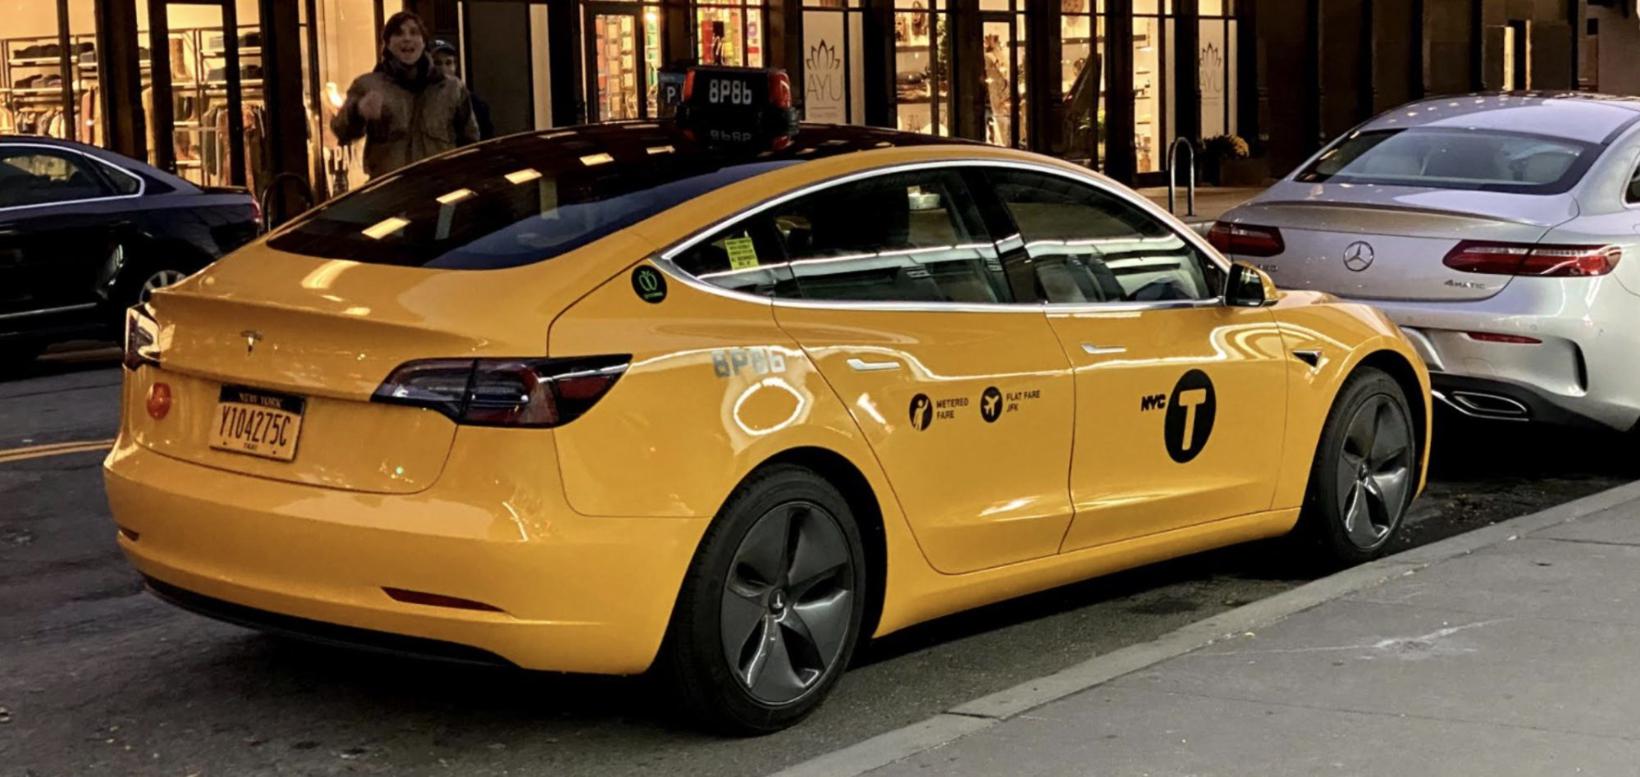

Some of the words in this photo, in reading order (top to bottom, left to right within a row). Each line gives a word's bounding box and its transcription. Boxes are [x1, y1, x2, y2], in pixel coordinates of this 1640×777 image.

[667, 86, 676, 104] P
[807, 74, 844, 101] AYU
[240, 393, 258, 403] NEW
[260, 396, 281, 408] YORK
[1006, 392, 1022, 401] FLAT
[1024, 390, 1041, 399] FARE
[936, 398, 969, 409] METERED
[1006, 403, 1019, 413] JFK
[937, 410, 955, 420] FARE
[1141, 394, 1166, 412] NYC
[1179, 388, 1207, 450] T
[219, 405, 291, 447] Y104275C
